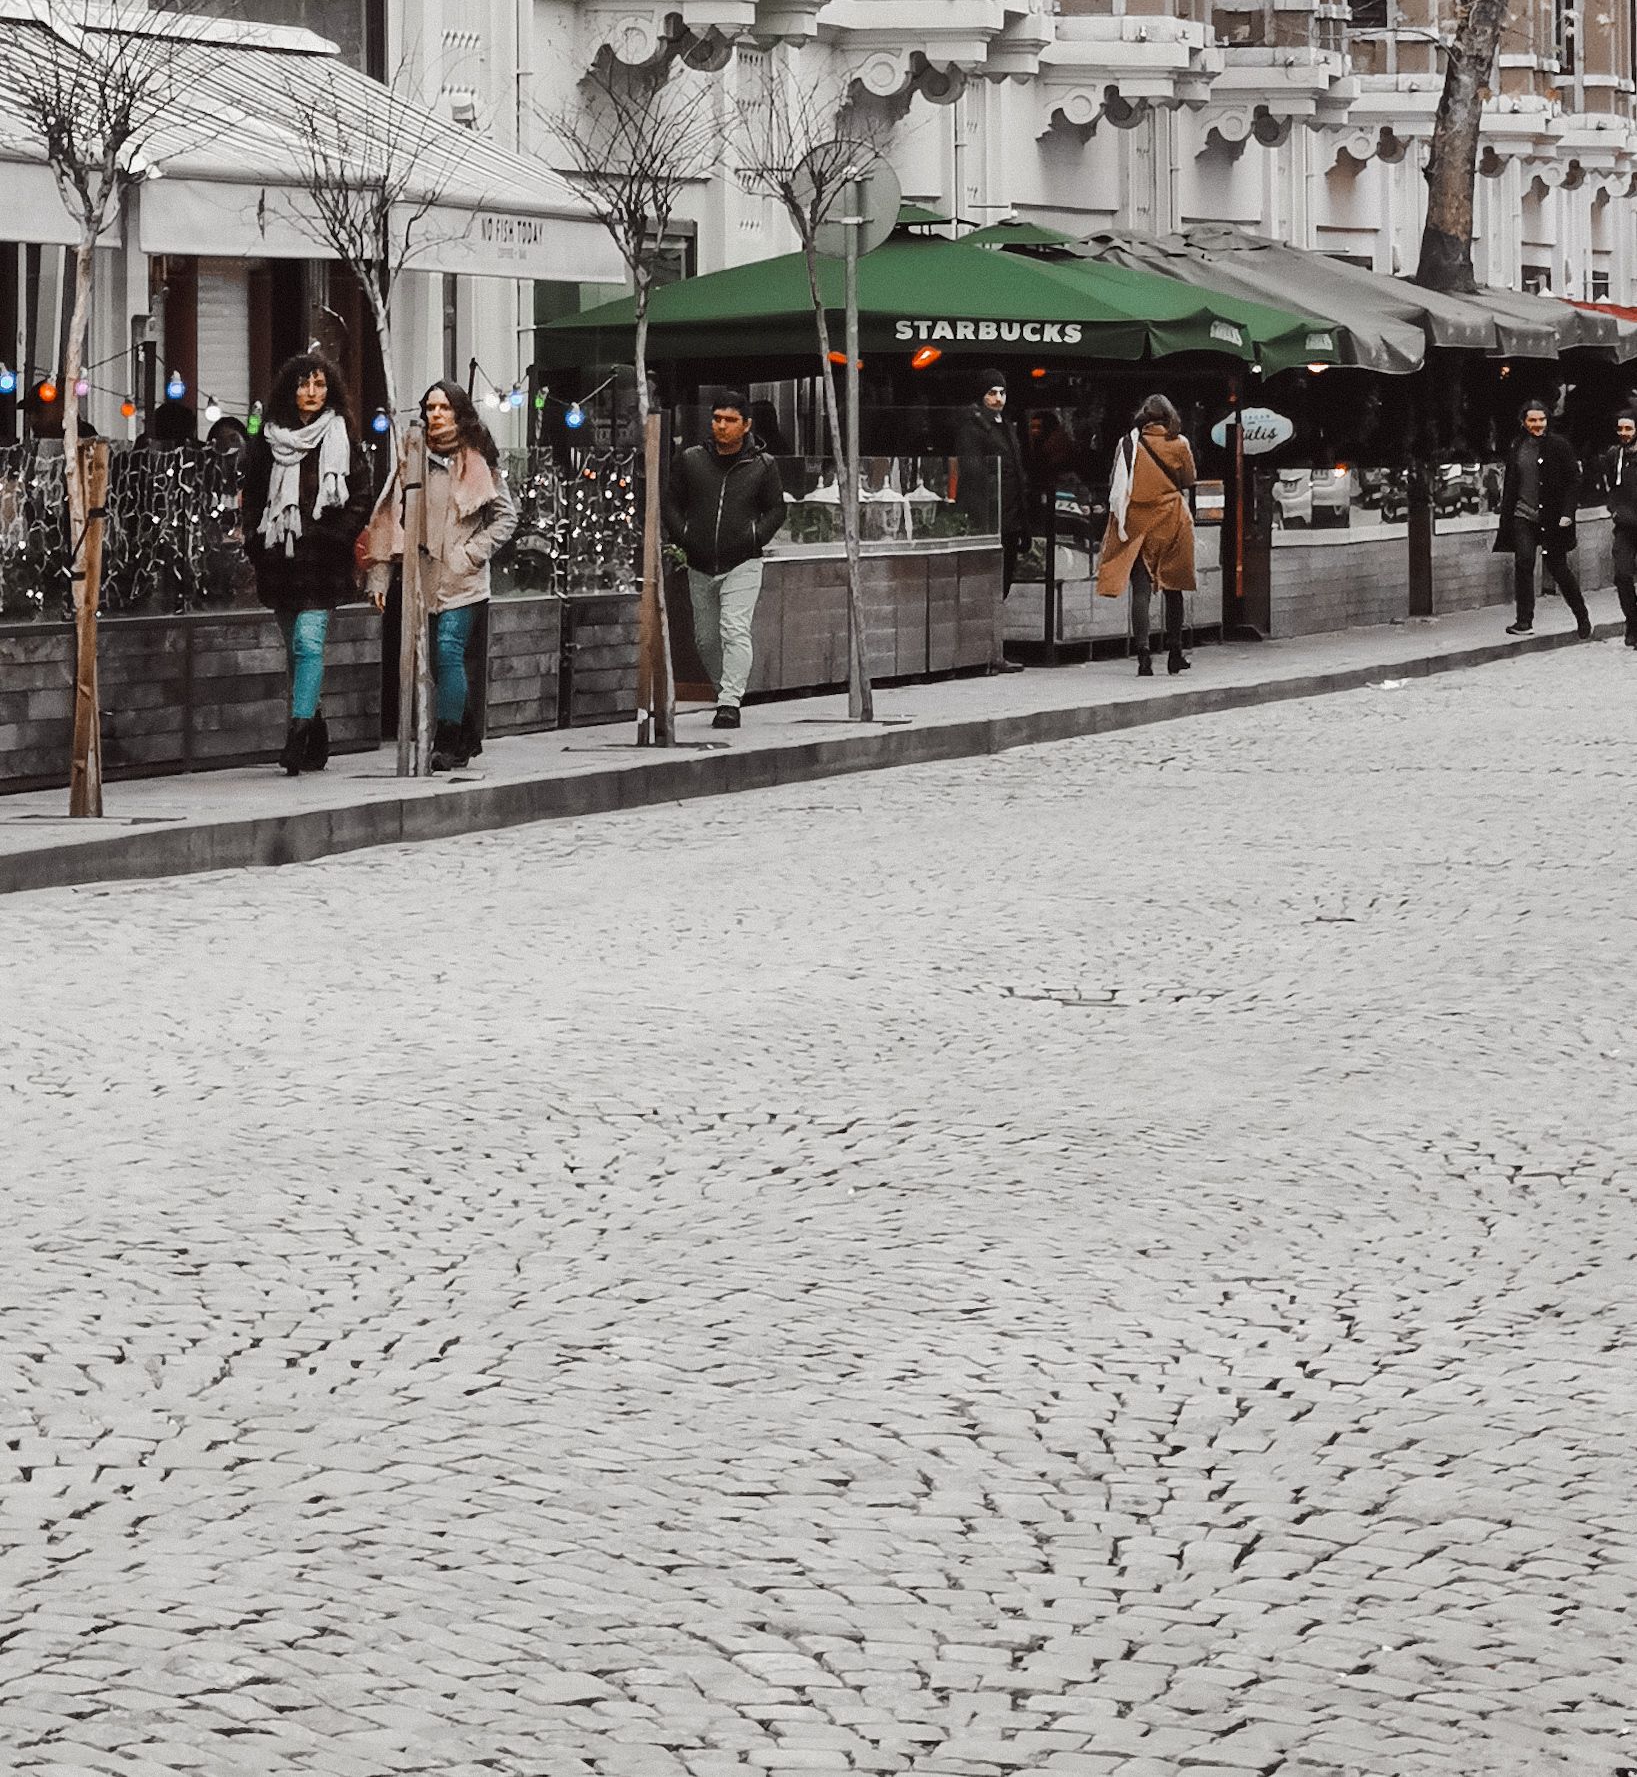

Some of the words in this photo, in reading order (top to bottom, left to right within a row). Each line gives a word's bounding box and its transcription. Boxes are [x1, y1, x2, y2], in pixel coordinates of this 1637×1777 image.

[481, 217, 493, 241] NO
[495, 218, 514, 243] FISH
[517, 220, 543, 244] TODAY
[895, 320, 1082, 343] STARBUCKS
